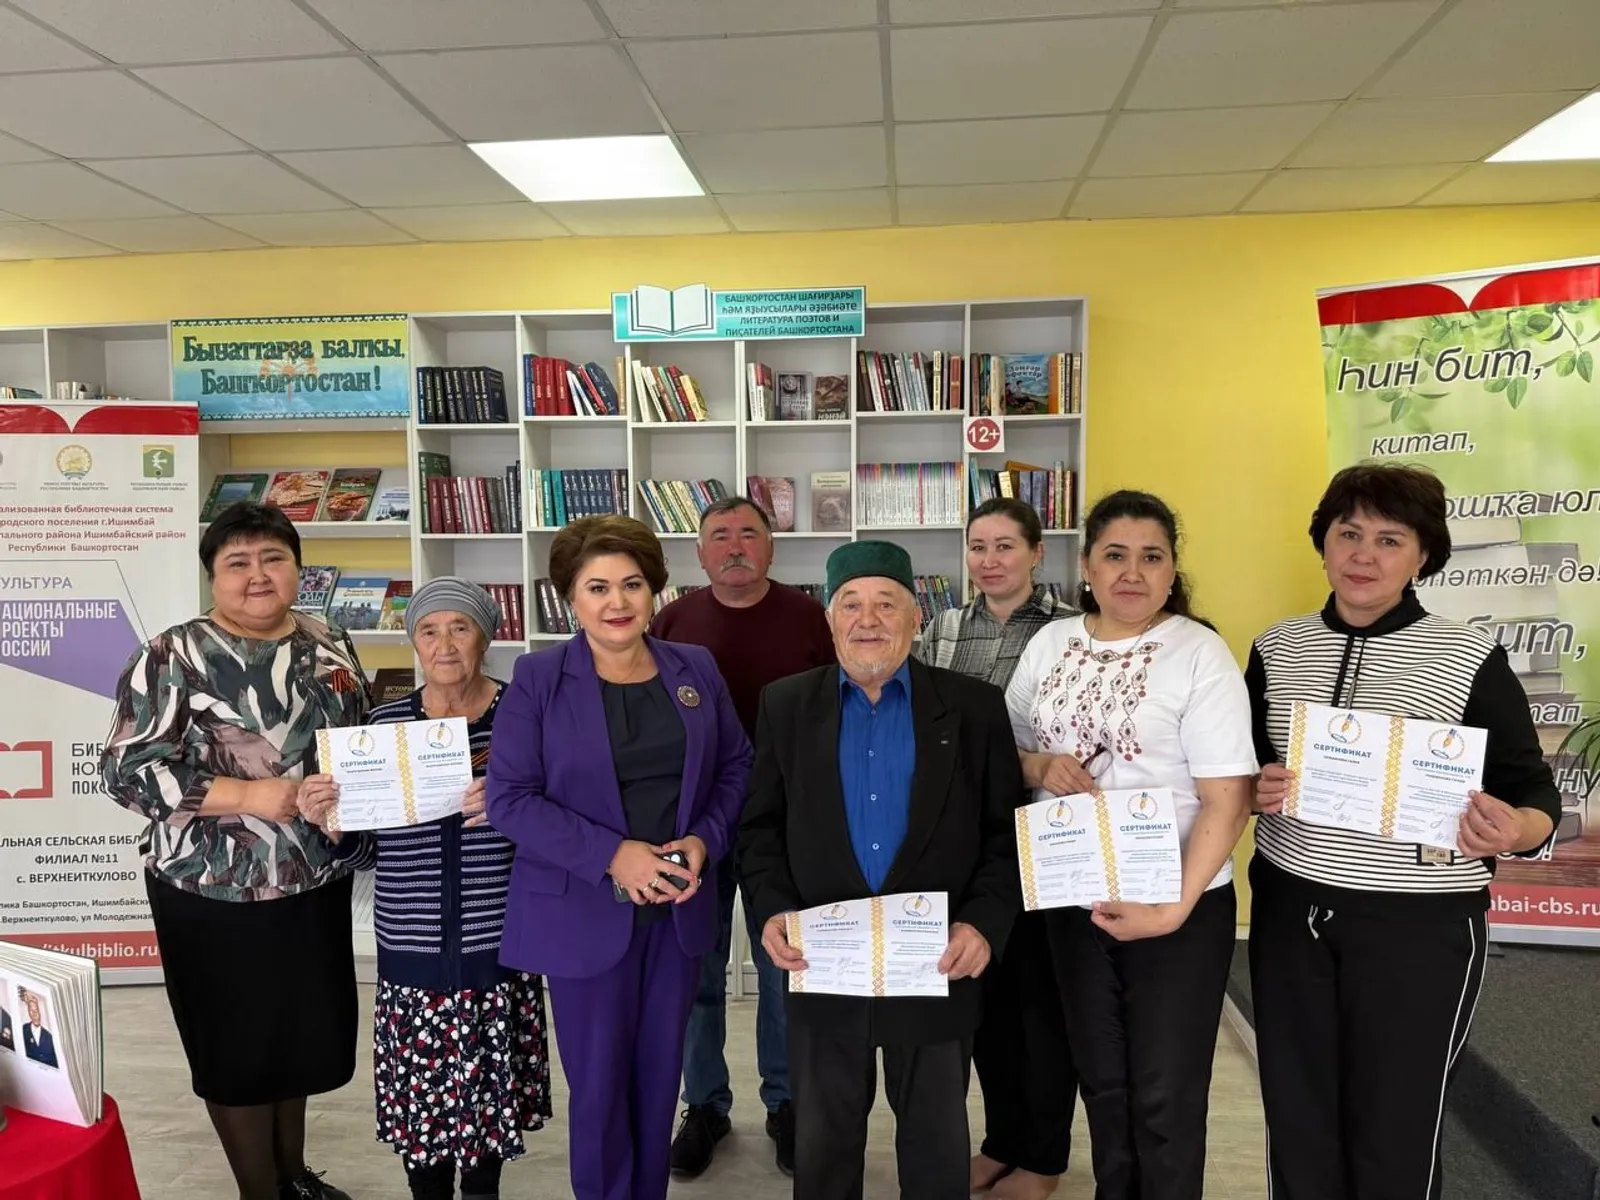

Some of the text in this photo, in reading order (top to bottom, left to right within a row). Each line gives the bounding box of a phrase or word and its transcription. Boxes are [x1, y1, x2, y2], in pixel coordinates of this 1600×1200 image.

[741, 316, 793, 325] ЛИТЕРАТУРА
[796, 315, 830, 323] ПОЭТОВ
[1435, 347, 1543, 381] бит,
[968, 425, 1001, 443] 12+
[1372, 432, 1475, 455] китап,
[64, 504, 133, 514] библиотечная
[135, 505, 173, 513] система
[47, 518, 99, 526] поселения
[46, 530, 81, 540] района
[83, 529, 154, 539] Ишимбайский
[156, 530, 186, 540] район
[8, 543, 139, 554] Республики Башкортостан
[0, 577, 72, 590] УЛЬТУРА
[2, 602, 117, 621] АЦИОНАЛЬНЫЕ
[2, 621, 64, 638] РОЕКТЫ
[0, 639, 51, 657] ОССИИ
[417, 751, 465, 760] СЕРТИФИКАТ
[1313, 743, 1372, 758] СЕРТИФИКАТ
[339, 758, 387, 768] СЕРТИФИКАТ
[1412, 760, 1476, 775] СЕРТИФИКАТ
[1119, 823, 1172, 832] СЕРТИФИКАТ
[1038, 828, 1086, 841] СЕРТИФИКАТ
[45, 835, 105, 847] СЕЛЬСКАЯ
[35, 853, 118, 865] ФИЛИАЛ №11
[16, 870, 137, 884] с. ВЕРХНЕИТКУЛОВО
[22, 898, 90, 909] Башкортостан,
[809, 920, 859, 929] СЕРТИФИКАТ
[892, 919, 942, 927] СЕРТИФИКАТ
